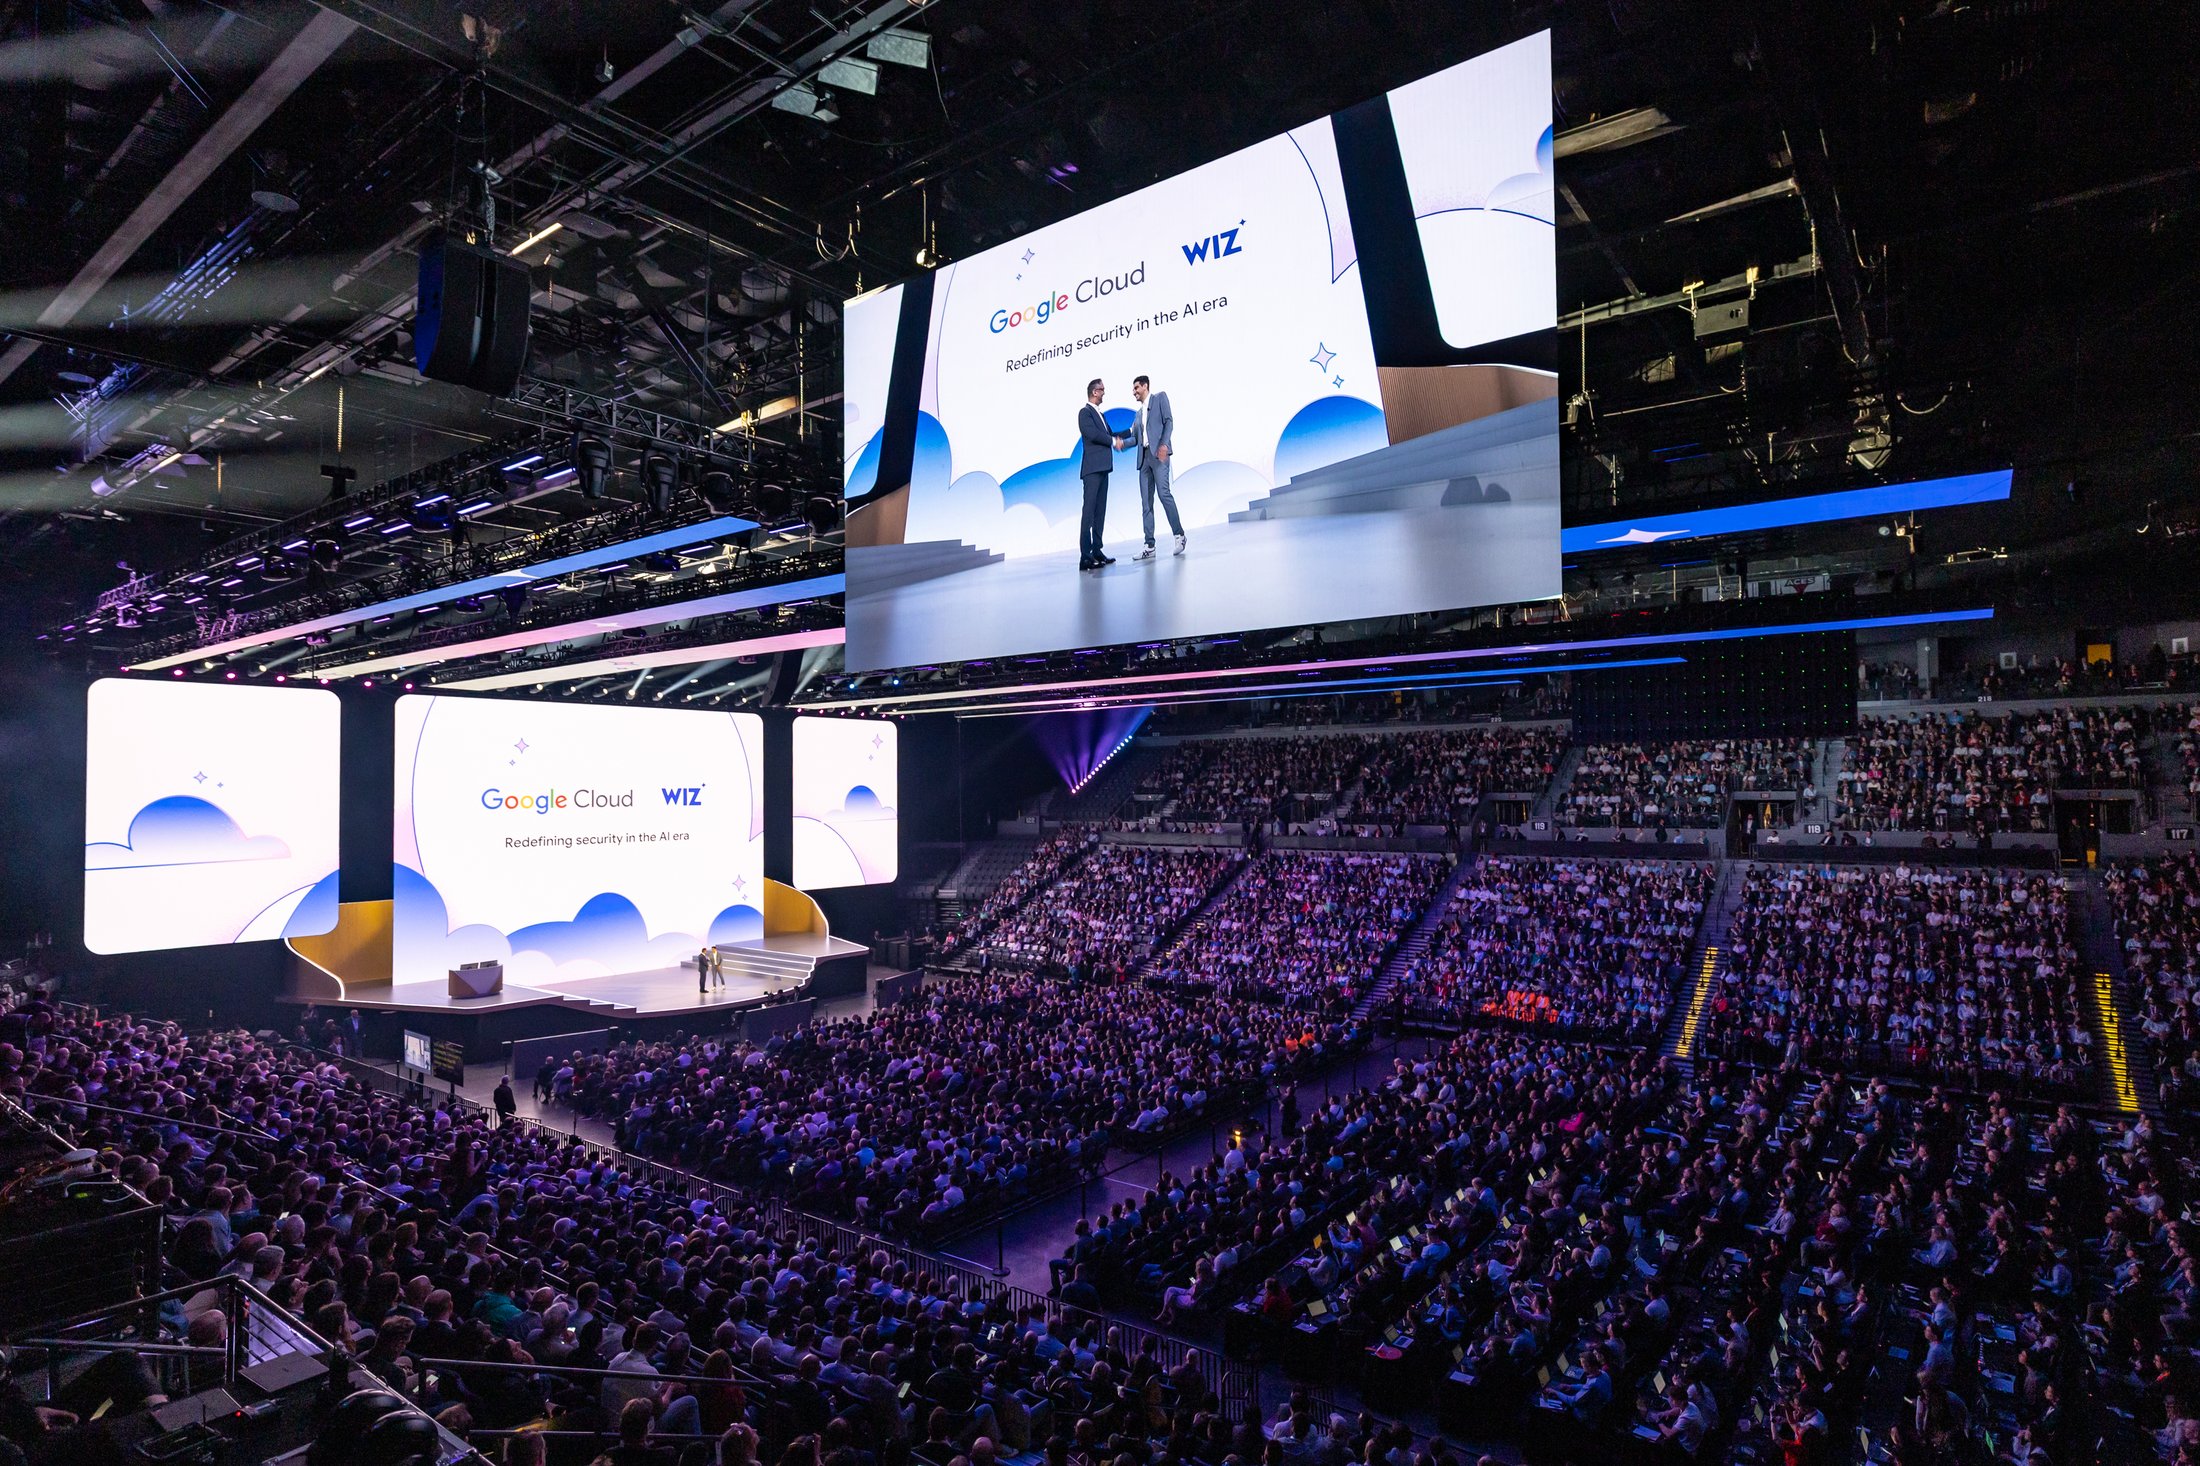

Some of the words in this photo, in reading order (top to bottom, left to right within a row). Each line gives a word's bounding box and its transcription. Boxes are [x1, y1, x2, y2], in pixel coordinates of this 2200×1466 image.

[1182, 227, 1242, 266] WIZ
[990, 291, 1069, 334] Google
[1075, 261, 1145, 304] Cloud
[1006, 339, 1073, 373] Redefining
[1076, 323, 1133, 351] security
[1137, 317, 1150, 332] in
[1153, 308, 1179, 327] the
[1182, 300, 1198, 319] AI
[1202, 295, 1228, 312] era
[481, 788, 568, 815] Google
[574, 789, 634, 808] Cloud
[661, 788, 702, 806] WIZ
[1534, 822, 1545, 830] 119
[1808, 824, 1821, 834] 118
[2171, 829, 2188, 839] 117
[505, 835, 573, 849] Redefining
[576, 833, 623, 846] security
[626, 832, 636, 843] in
[638, 831, 657, 842] the
[659, 831, 670, 841] AI
[673, 832, 690, 841] era
